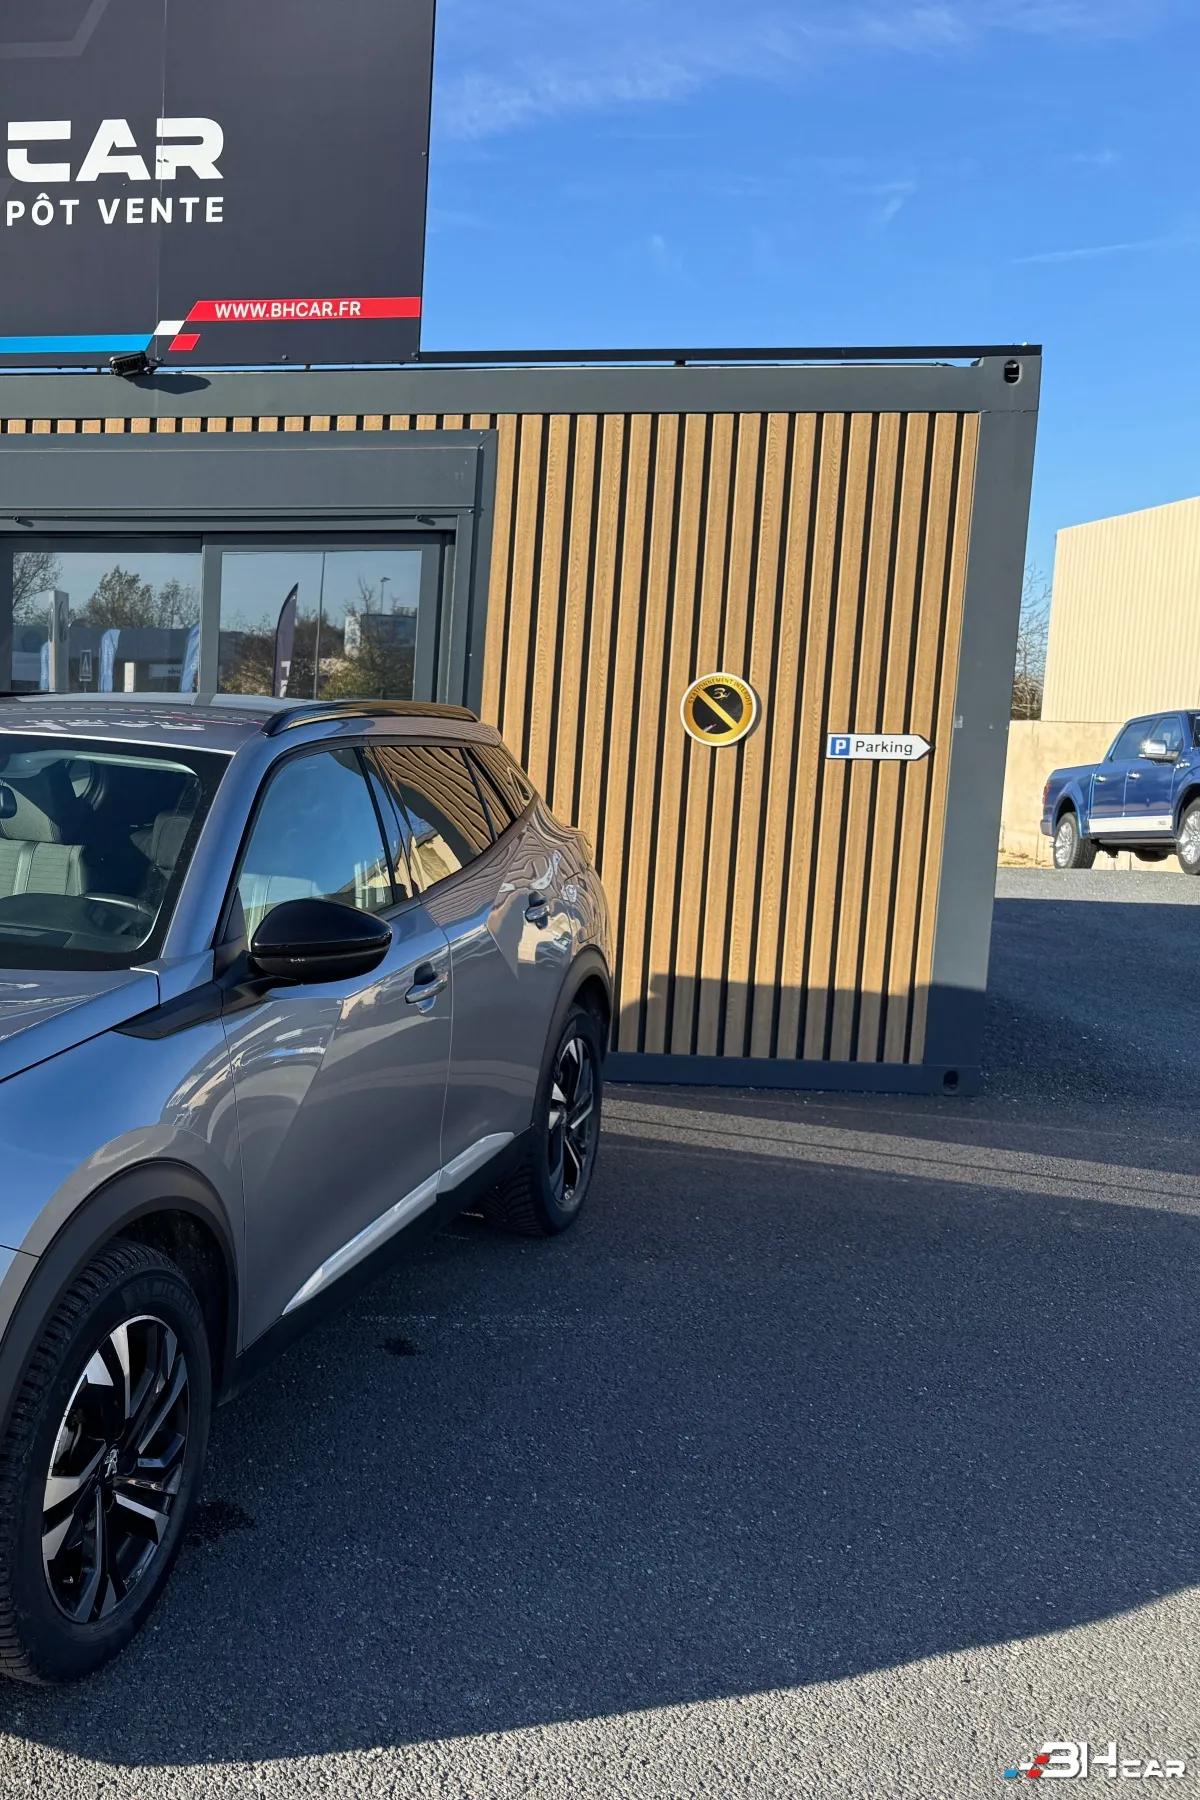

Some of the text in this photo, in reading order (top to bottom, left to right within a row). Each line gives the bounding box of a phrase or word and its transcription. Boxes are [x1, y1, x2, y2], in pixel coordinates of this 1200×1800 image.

[97, 196, 224, 225] VENTE
[215, 301, 361, 319] WWW.BHCAR.FR
[855, 740, 913, 756] Parking
